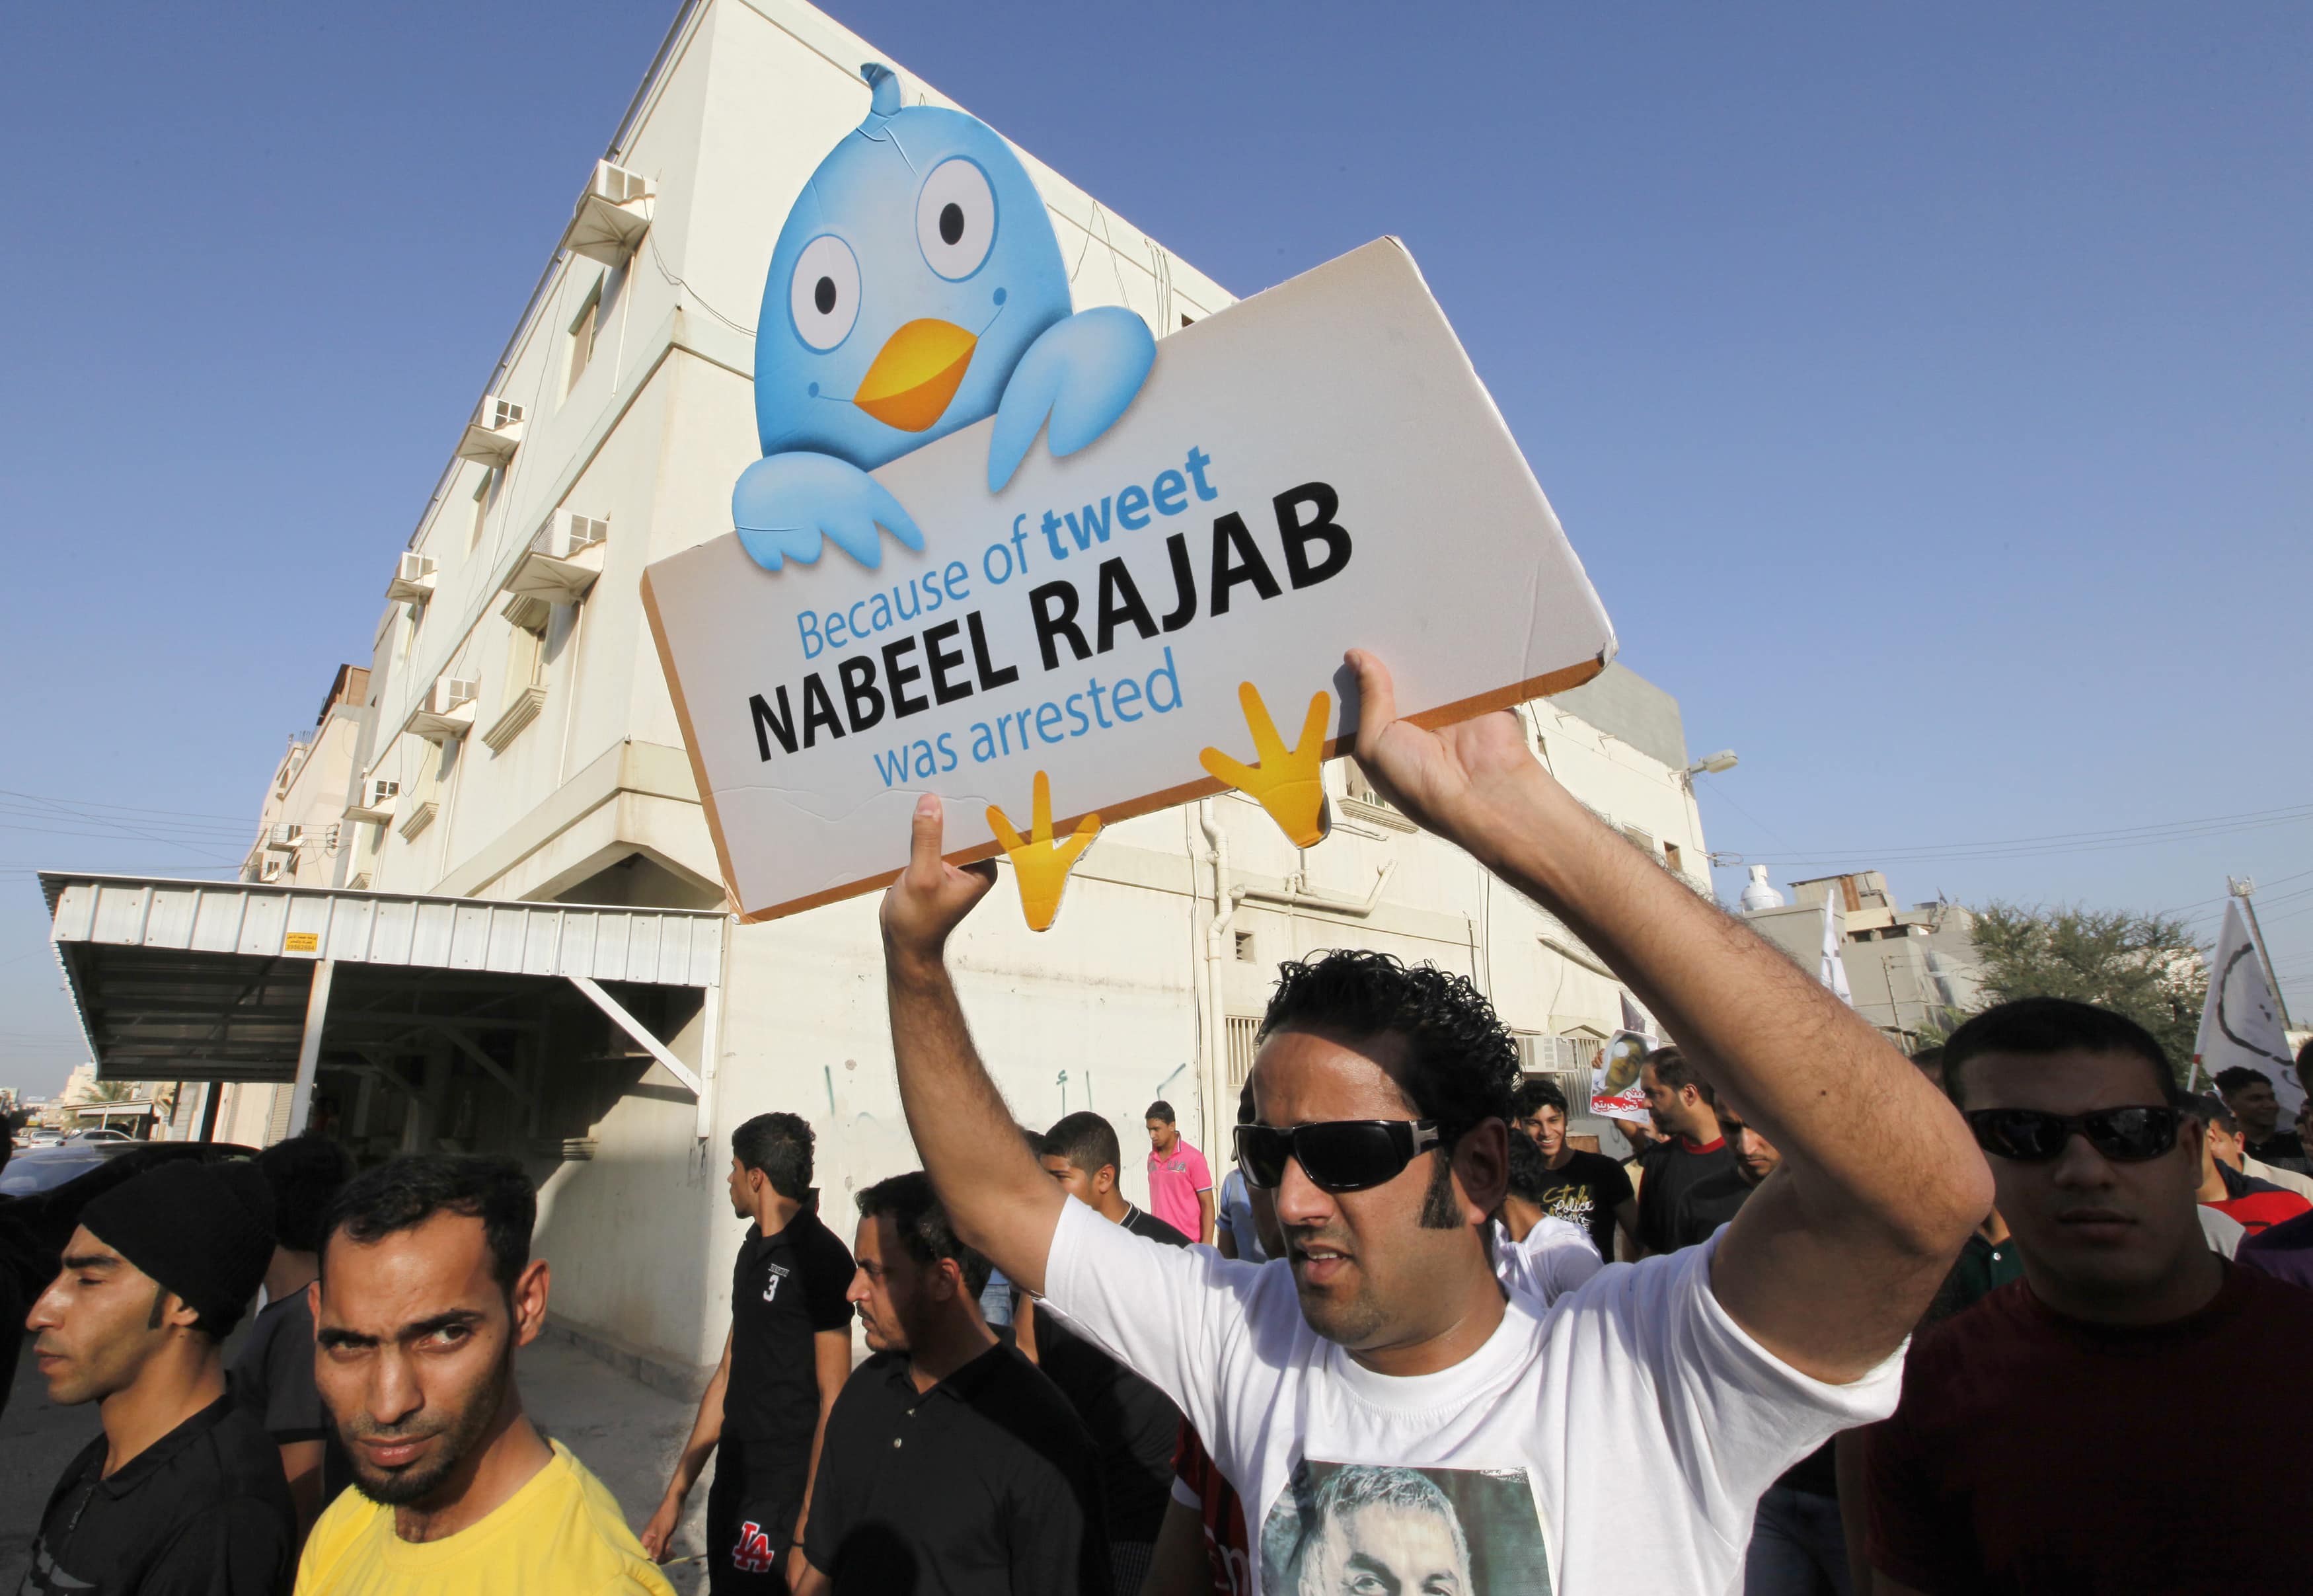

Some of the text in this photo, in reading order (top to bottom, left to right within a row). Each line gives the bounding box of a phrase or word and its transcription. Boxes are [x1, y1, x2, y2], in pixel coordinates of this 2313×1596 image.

[797, 445, 1219, 660] Because of tweet
[748, 481, 1353, 762] NABEEL RAJAB
[873, 646, 1183, 787] was arrested
[1593, 1100, 1619, 1112] حريتي
[1552, 1199, 1595, 1214] Police
[763, 1274, 779, 1301] 3
[732, 1521, 775, 1572] LA
